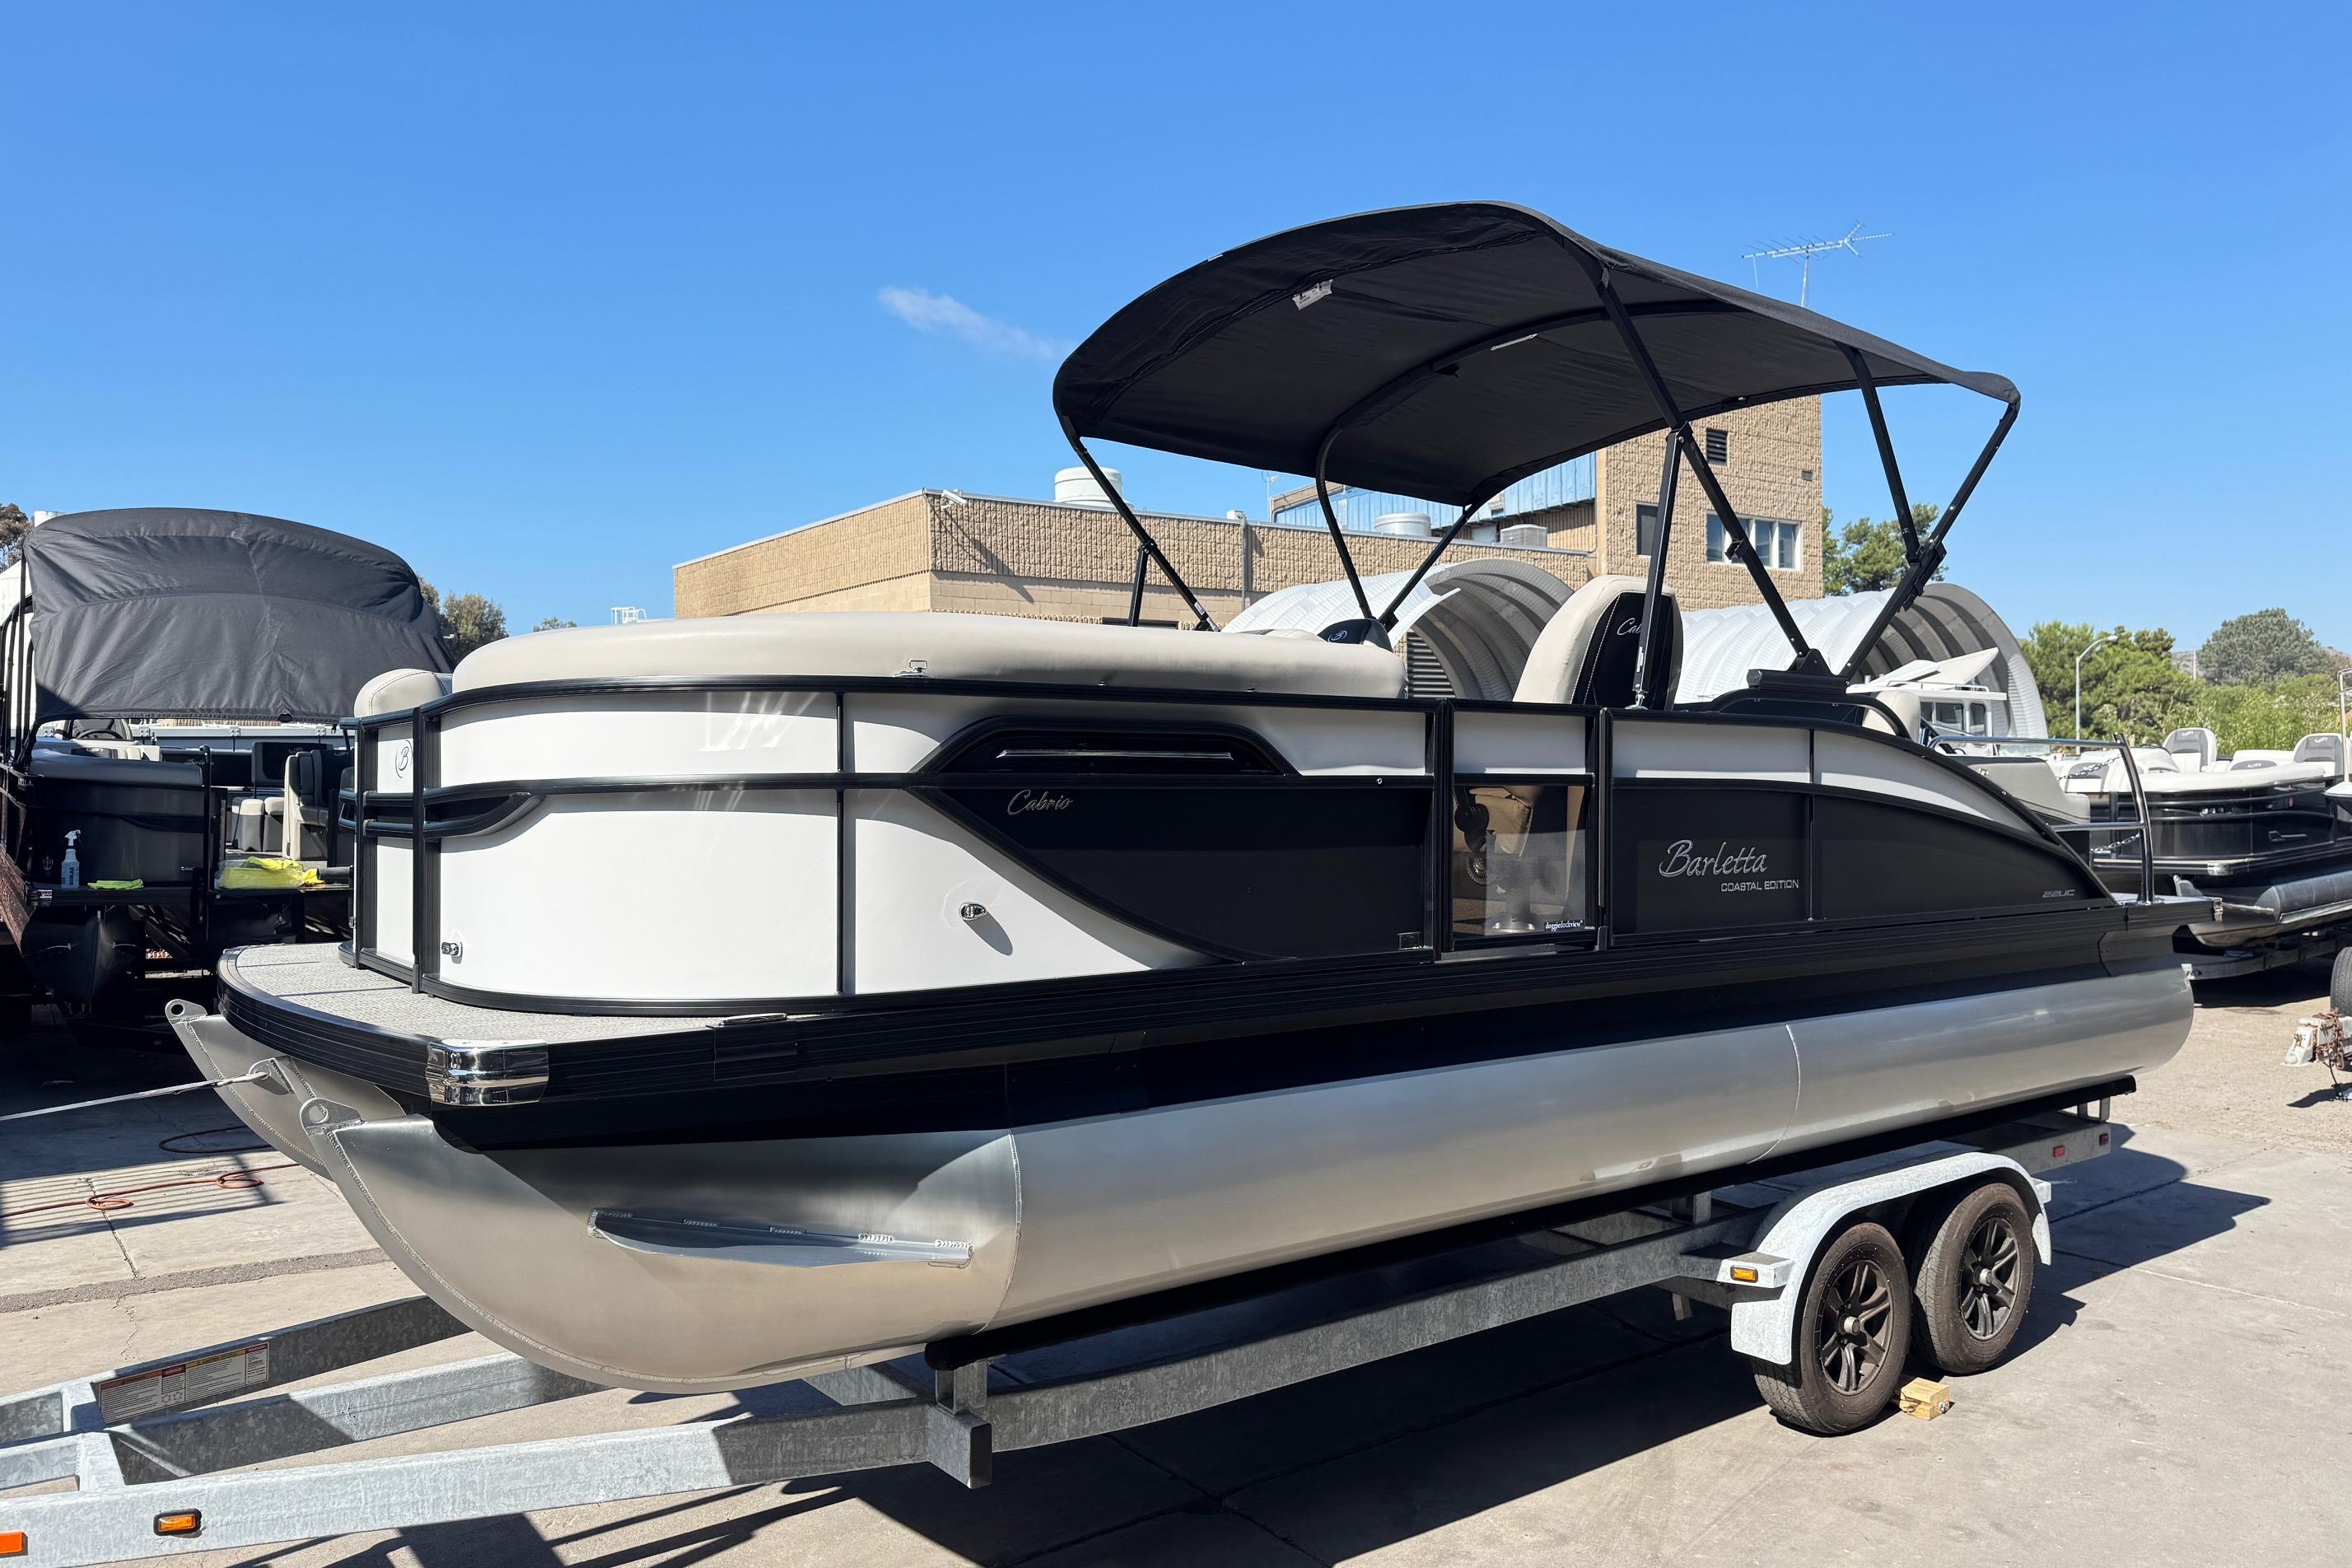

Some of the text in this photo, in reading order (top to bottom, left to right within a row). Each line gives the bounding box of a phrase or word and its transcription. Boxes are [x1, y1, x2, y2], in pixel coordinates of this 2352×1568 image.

[1617, 617, 1642, 636] Cab
[1007, 789, 1074, 816] Cabrio
[1659, 839, 1768, 878] Barletta
[1720, 879, 1799, 892] COASTAL EDITION
